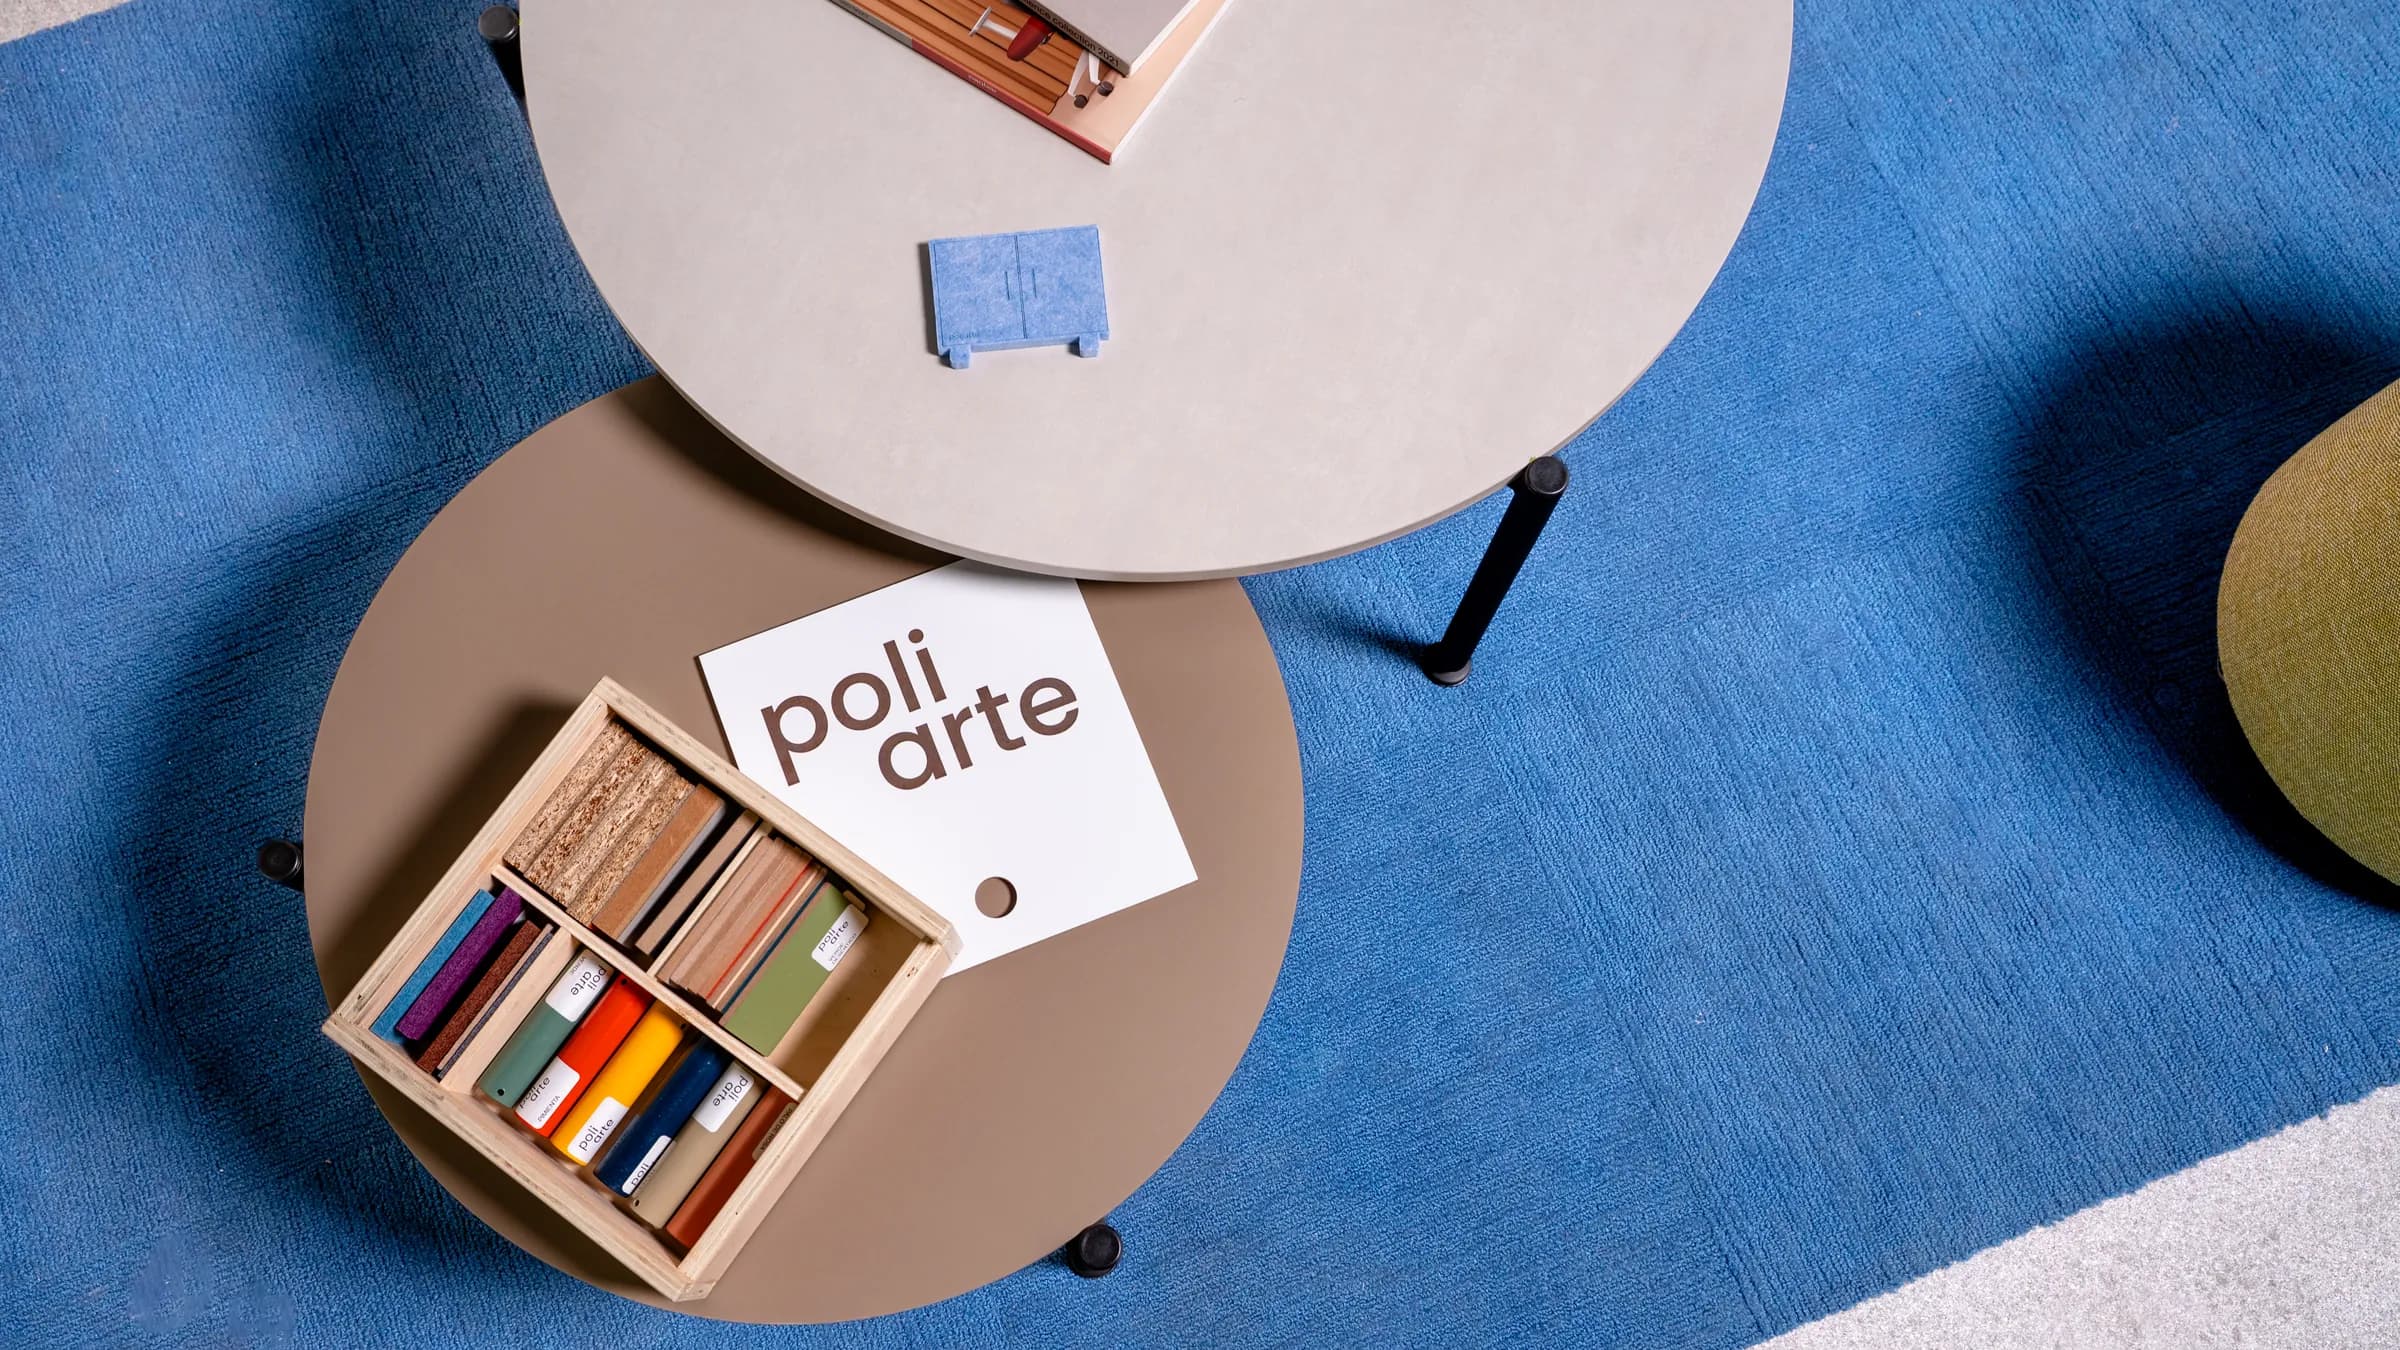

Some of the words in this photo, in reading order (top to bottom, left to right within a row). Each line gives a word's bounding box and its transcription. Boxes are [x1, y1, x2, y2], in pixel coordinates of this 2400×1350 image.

[1053, 17, 1096, 53] collection
[1098, 48, 1120, 68] 2021
[761, 628, 947, 786] poli
[878, 677, 1079, 790] arte
[818, 928, 836, 952] poli
[830, 920, 849, 945] arte
[570, 971, 592, 996] arte
[587, 964, 607, 991] poli
[530, 1077, 551, 1102] arte
[712, 1081, 734, 1107] arte
[728, 1074, 749, 1102] poli
[578, 1125, 599, 1151] poli
[593, 1119, 614, 1144] arte
